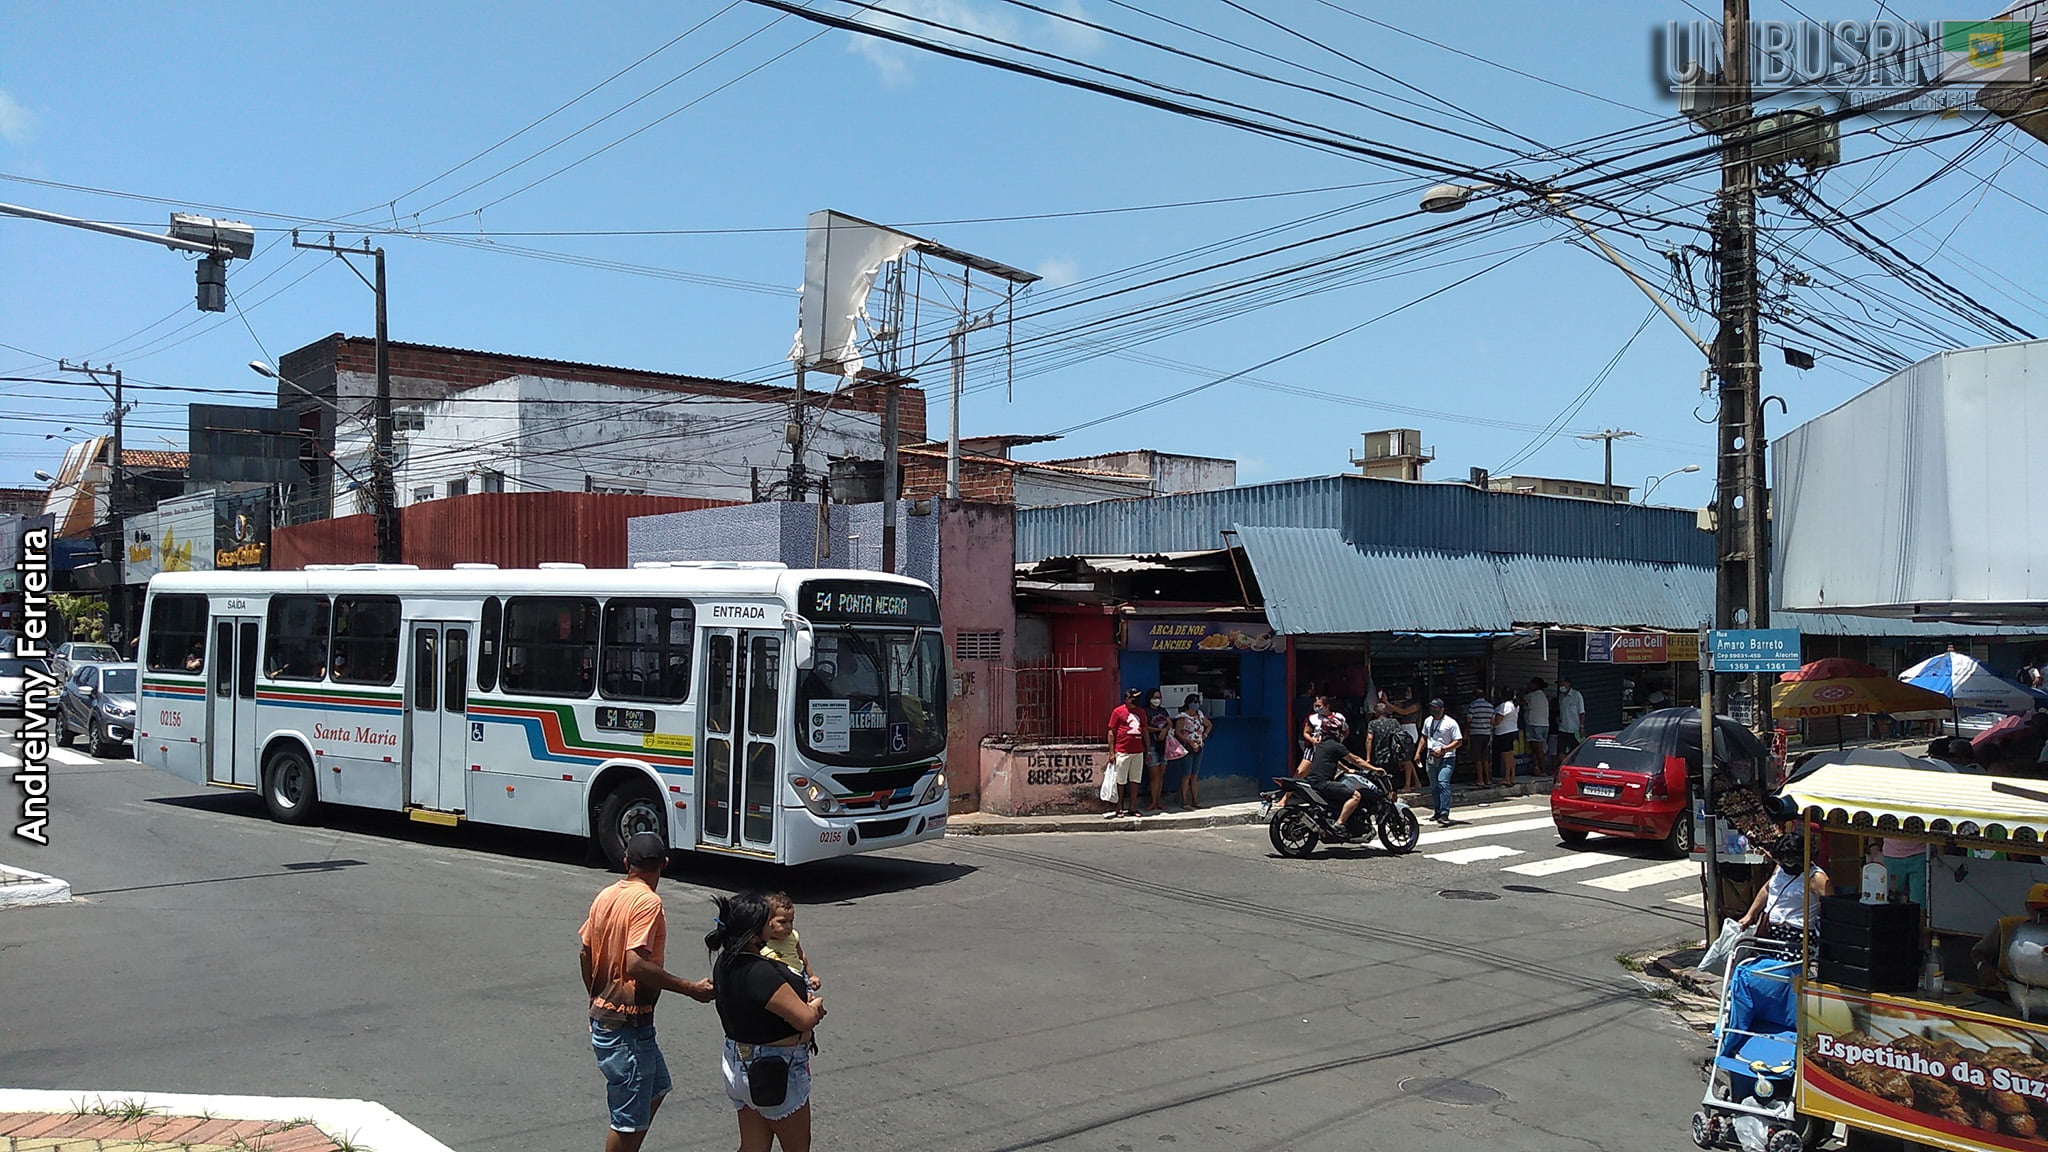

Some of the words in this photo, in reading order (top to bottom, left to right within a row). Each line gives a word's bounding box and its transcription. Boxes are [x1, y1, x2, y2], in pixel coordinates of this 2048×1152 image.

[227, 599, 246, 609] SAÍDA
[815, 592, 832, 611] 54
[838, 593, 872, 614] PONTA
[875, 596, 908, 615] NEGRA
[713, 606, 765, 619] ENTRADA
[1149, 625, 1174, 635] ARCA
[1174, 625, 1187, 635] DE
[1151, 639, 1193, 650] LANCHES
[1644, 634, 1663, 648] Cell
[1717, 639, 1745, 650] Amaro
[1750, 638, 1784, 650] Barreto
[1798, 704, 1836, 716] AQUI
[1842, 703, 1870, 713] TEM
[160, 710, 182, 727] 02156
[607, 709, 618, 728] 54
[849, 713, 887, 729] ALECRIM
[313, 722, 350, 742] Santa
[354, 726, 397, 746] Maria
[1027, 754, 1094, 768] DETETIVE
[819, 831, 842, 843] 02156
[1816, 1033, 1946, 1078] Espetinho
[1951, 1061, 1986, 1086] da
[1992, 1067, 2048, 1100] Suz
